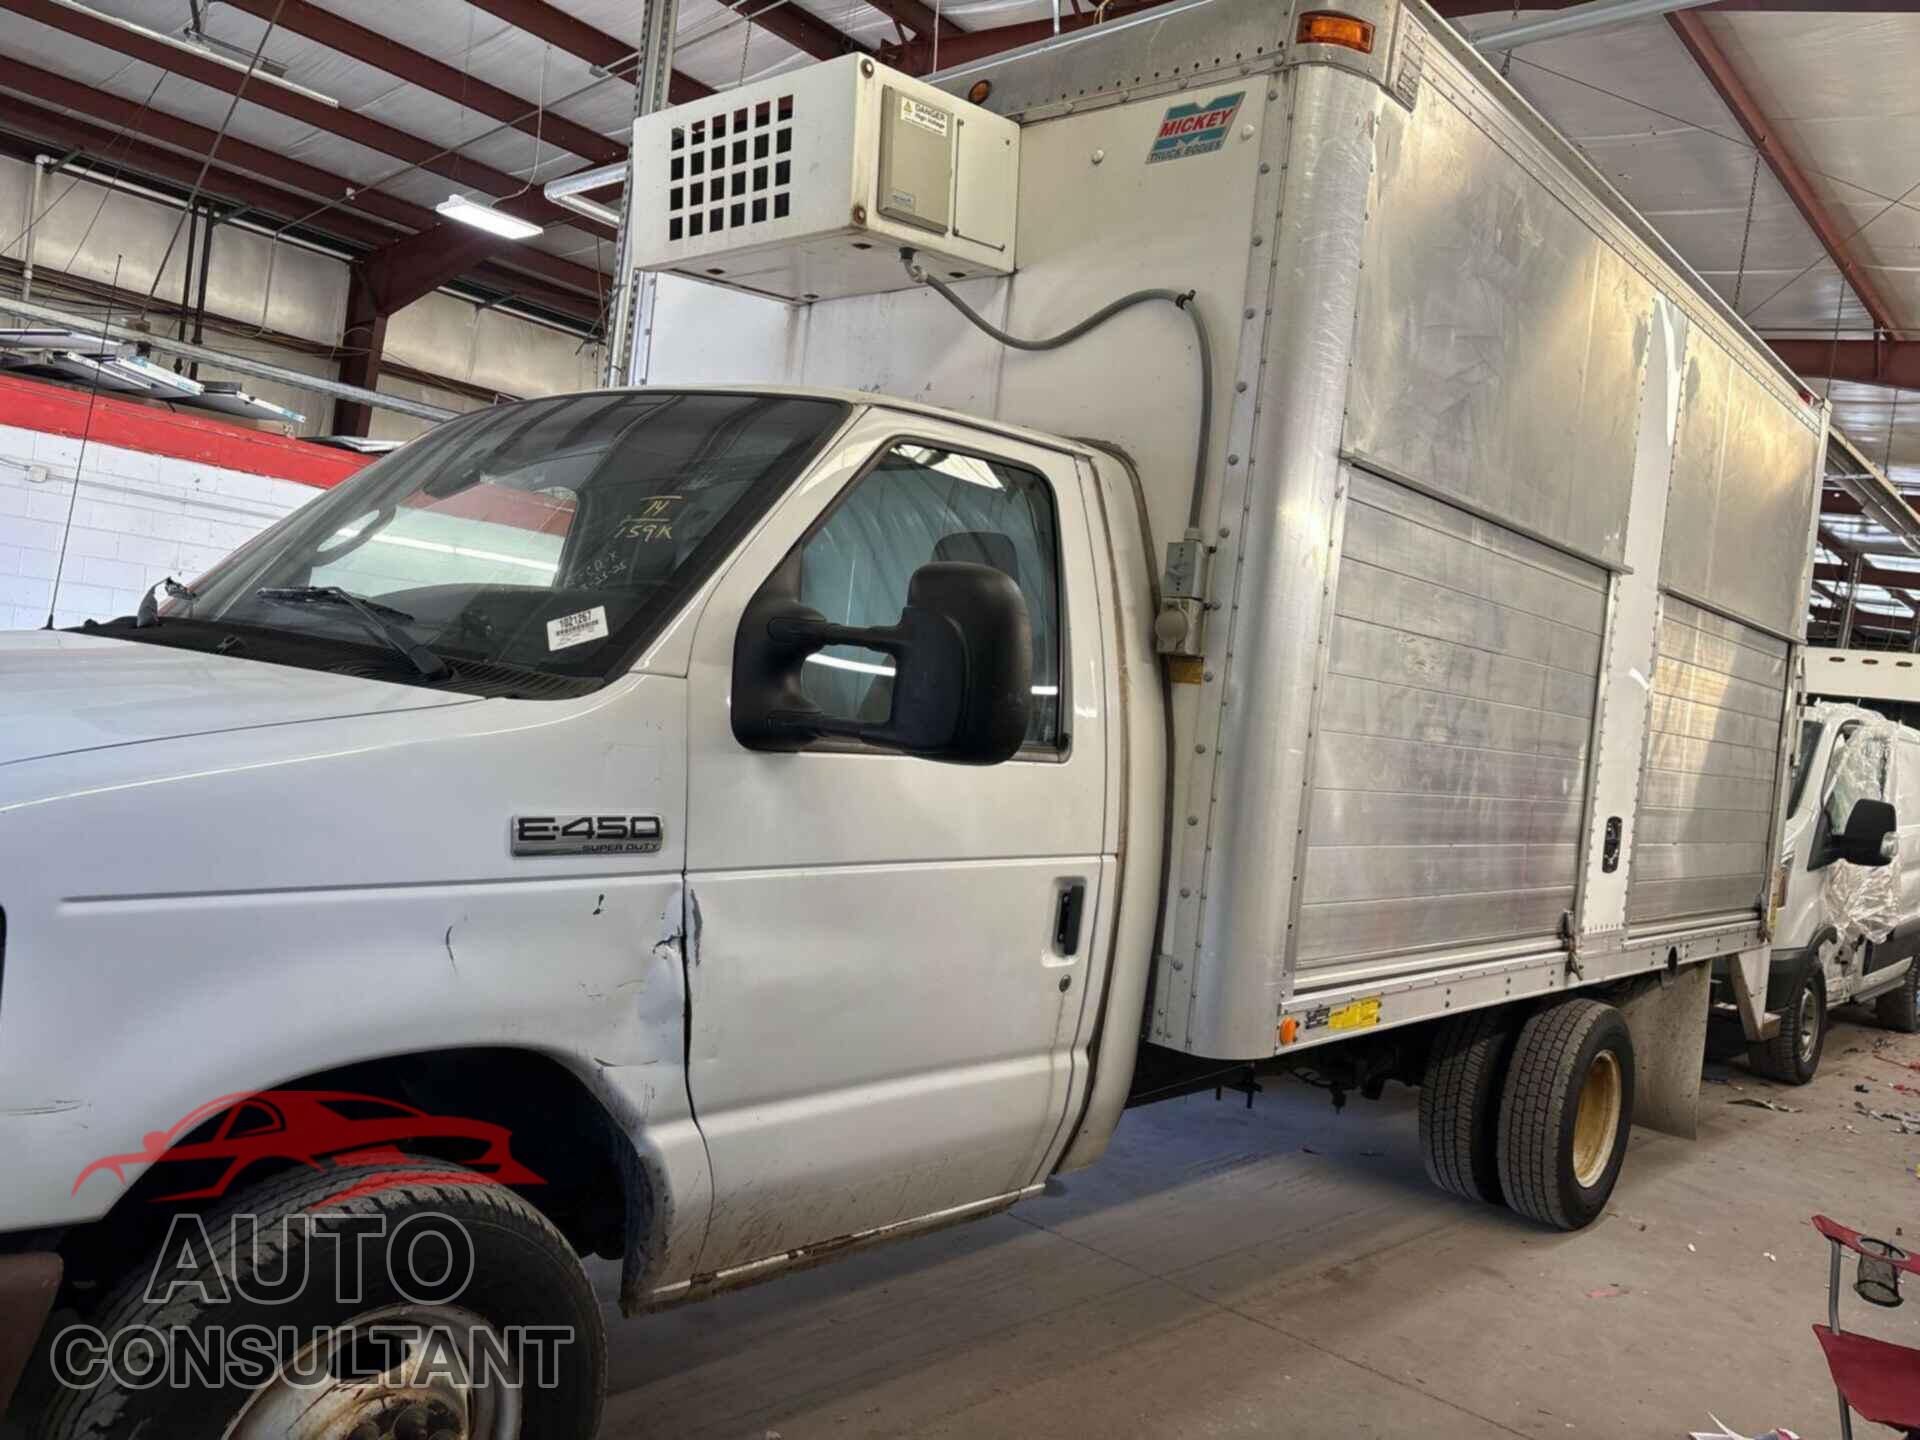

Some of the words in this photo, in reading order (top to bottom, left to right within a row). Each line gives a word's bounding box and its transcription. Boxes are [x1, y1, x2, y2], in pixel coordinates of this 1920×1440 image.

[914, 103, 945, 120] DANGER
[1158, 109, 1234, 138] MICKEY
[518, 816, 661, 841] E-450
[582, 843, 624, 853] SUPER
[624, 842, 658, 852] DUTY
